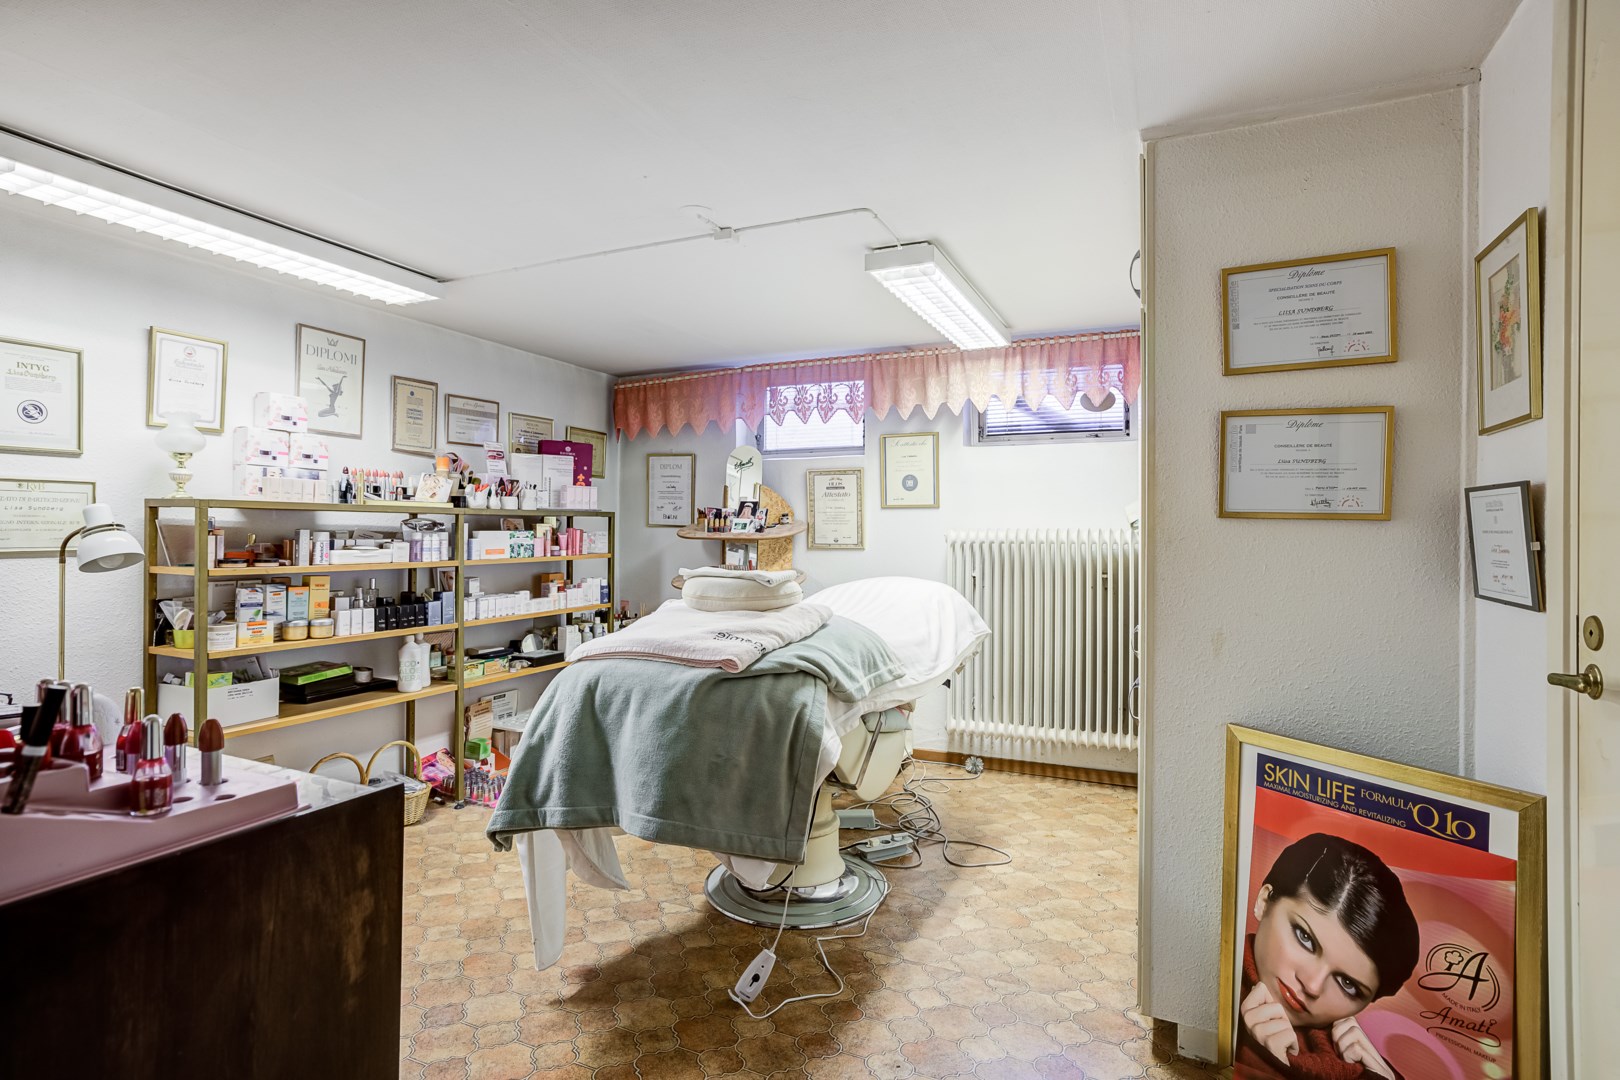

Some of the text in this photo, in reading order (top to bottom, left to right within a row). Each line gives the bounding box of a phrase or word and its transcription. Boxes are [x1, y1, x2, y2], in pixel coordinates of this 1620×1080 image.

[1287, 267, 1326, 282] Diplôme
[16, 361, 50, 372] INTYG
[1286, 418, 1325, 432] Diplôme
[1264, 762, 1310, 793] SKIN
[1317, 777, 1356, 806] LIFE
[1360, 788, 1414, 811] FORMULA
[1263, 781, 1407, 828] MAXIMAL MOISTURIZING AND REVITALIZING
[1441, 992, 1458, 1007] MADE
[1459, 1004, 1466, 1012] IN
[1419, 1006, 1498, 1035] Amati
[1435, 1032, 1497, 1064] PROFESSIONAL MAKEUP
